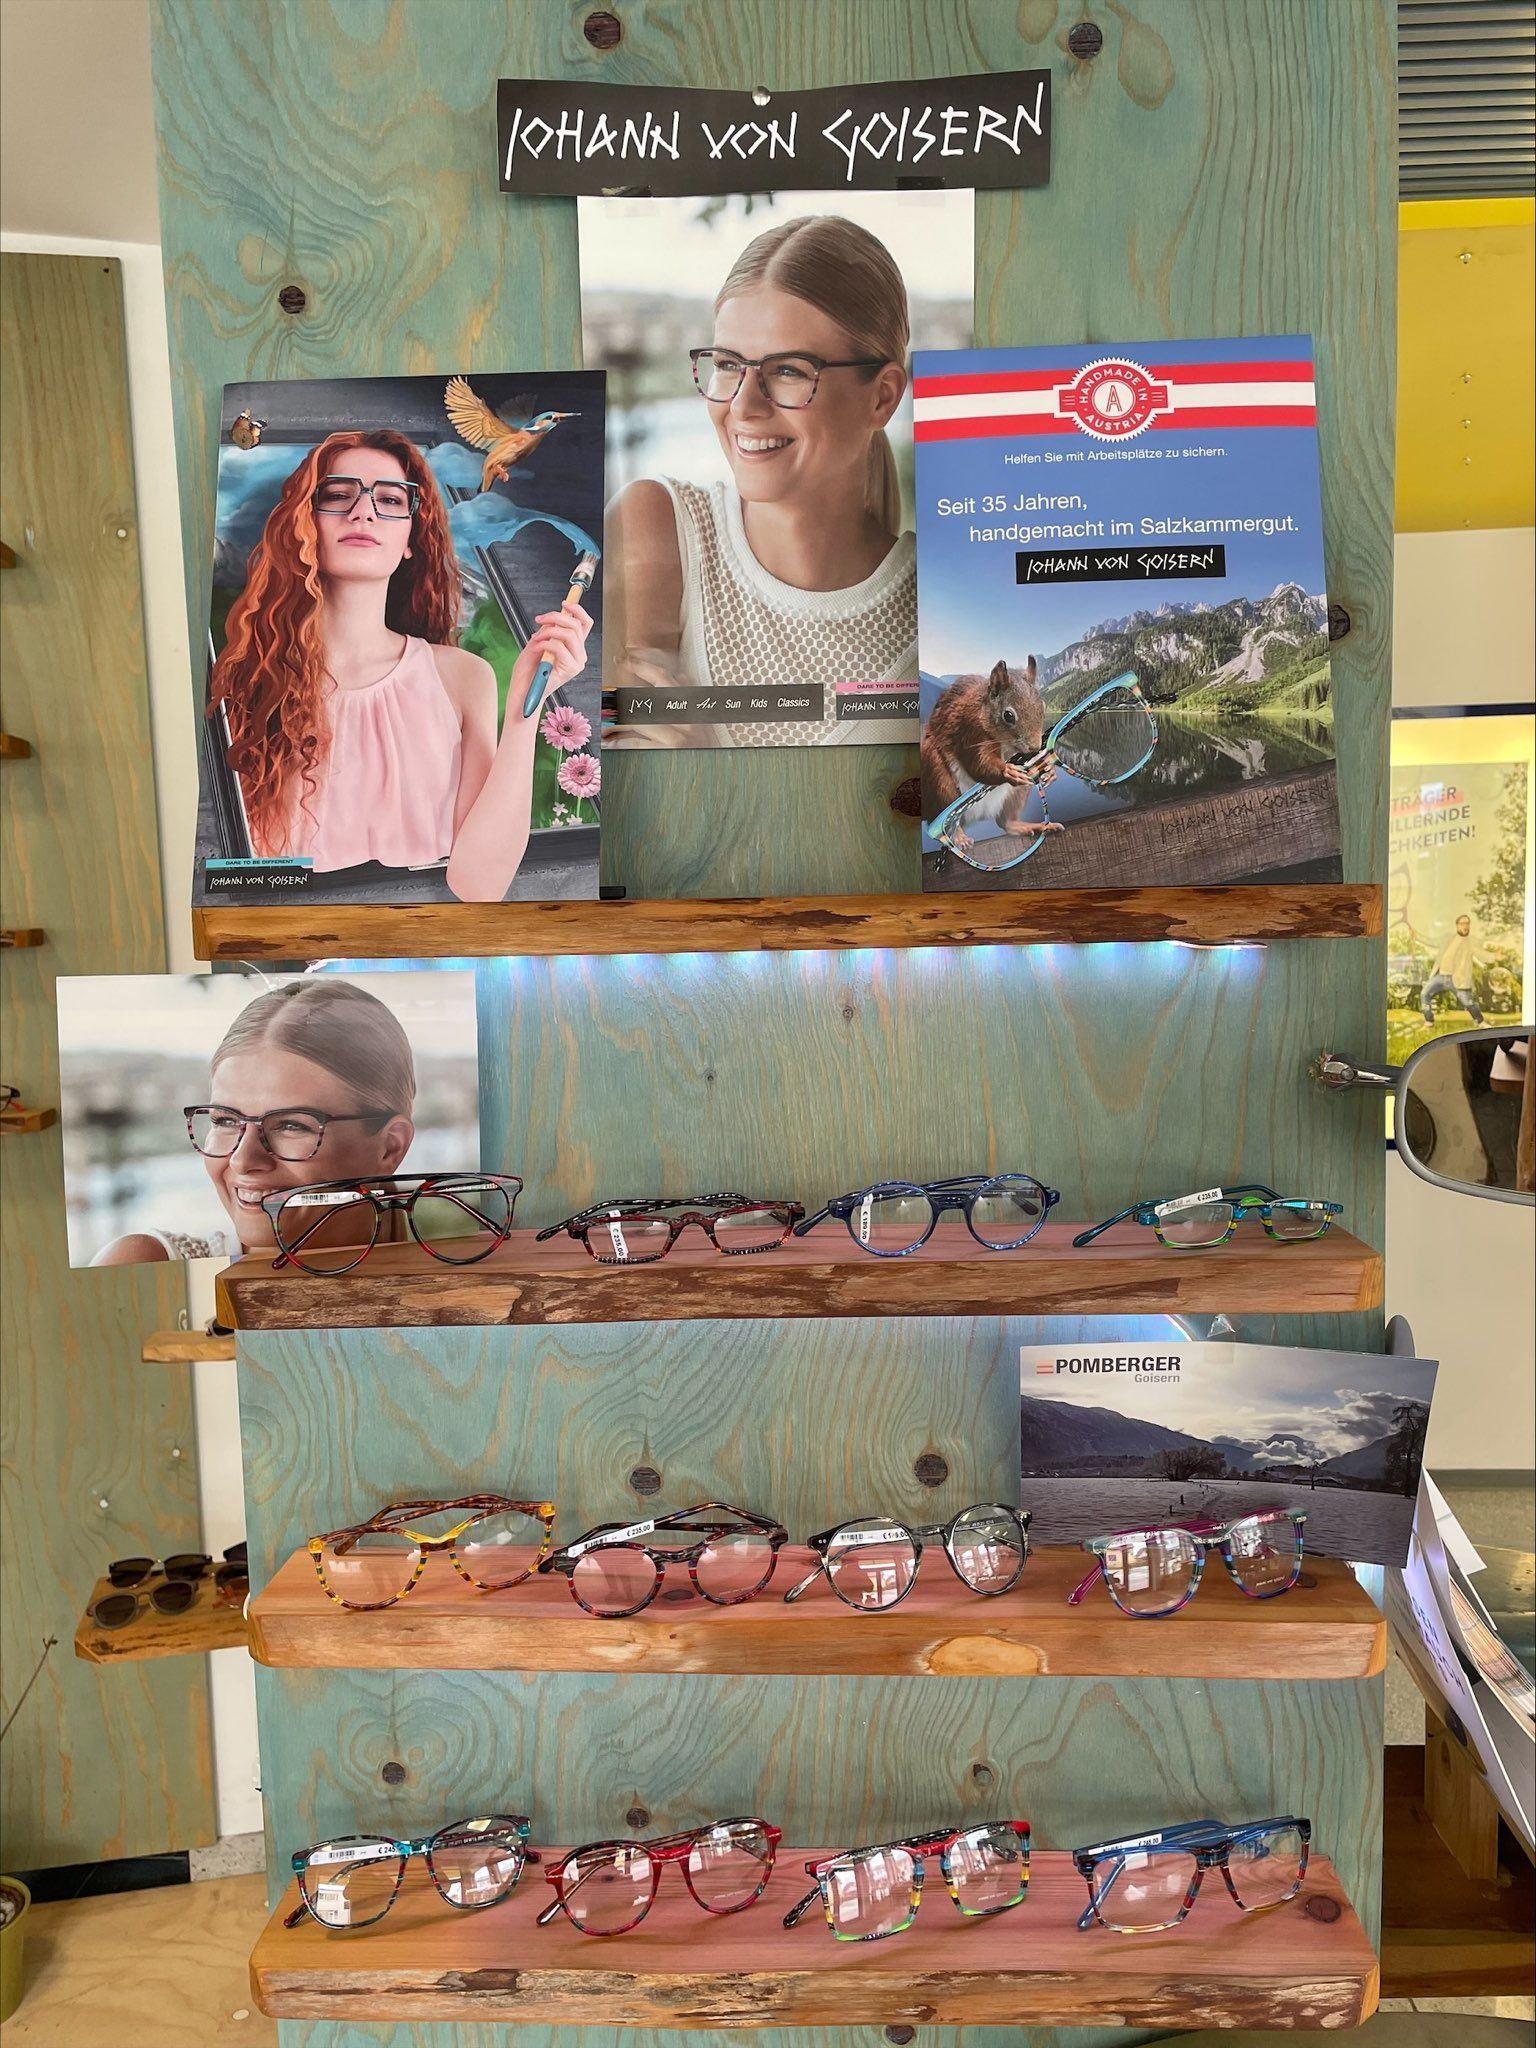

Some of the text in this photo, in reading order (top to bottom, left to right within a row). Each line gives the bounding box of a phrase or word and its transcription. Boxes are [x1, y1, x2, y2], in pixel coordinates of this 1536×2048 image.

[504, 81, 1045, 182] JOHANN VON GOISERN
[1079, 368, 1149, 432] HANDMADE IN AUSTRIA
[1004, 446, 1228, 465] Helfen Sie mit Arbeitsplätze zu sichern.
[936, 493, 1089, 517] Seit 35 Jahren,
[969, 513, 1300, 545] handgemacht im Salzkammergut.
[1026, 547, 1214, 581] JOHANN VON GOISERN
[666, 700, 688, 710] Adult
[725, 699, 741, 709] Sun
[750, 698, 768, 709] Kids
[777, 697, 810, 708] Classics
[841, 700, 876, 716] JOHANN
[879, 700, 899, 710] VON
[1161, 779, 1332, 845] JOHANN VON GOISERN
[209, 873, 308, 890] JOHANN VON GOISERN
[1201, 1190, 1219, 1201] 235.00
[1055, 1356, 1182, 1374] POMBERGER
[1134, 1373, 1181, 1383] Goisern
[631, 1524, 651, 1536] 235.00
[378, 1846, 383, 1854] €
